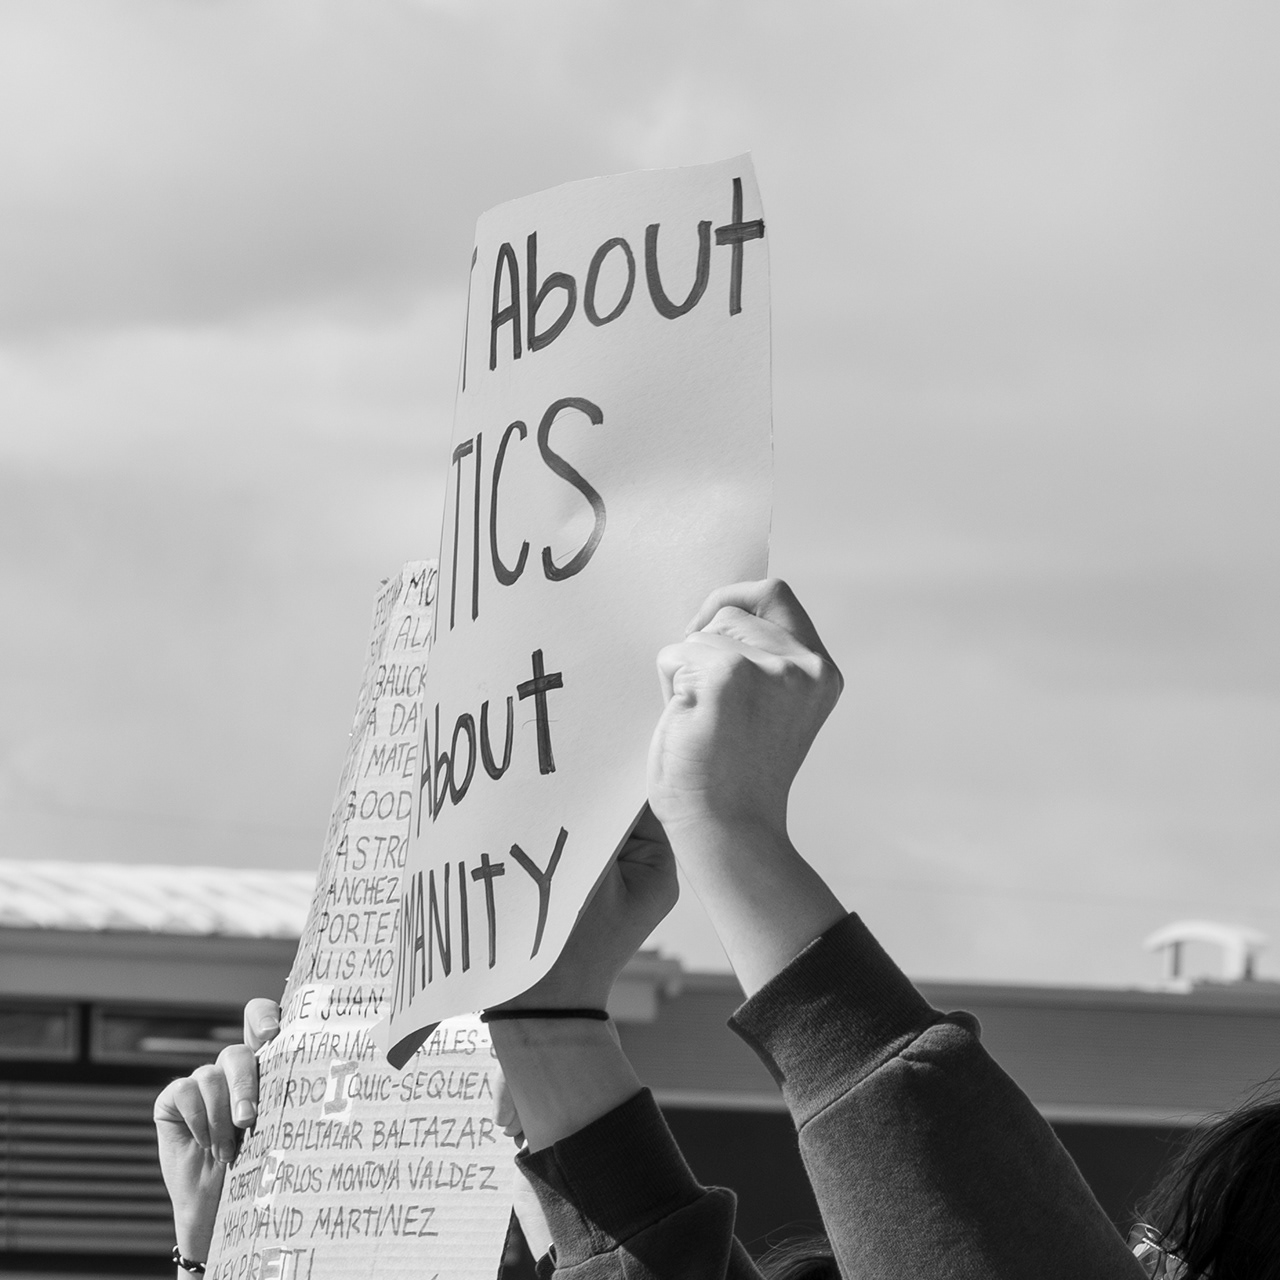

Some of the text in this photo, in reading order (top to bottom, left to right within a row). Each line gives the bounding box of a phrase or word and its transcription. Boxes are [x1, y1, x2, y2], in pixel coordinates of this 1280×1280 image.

[489, 177, 766, 372] About
[413, 646, 564, 838] About
[327, 875, 401, 907] ANCHEZ
[281, 1117, 363, 1152] BALTAZAR
[372, 1115, 498, 1152] BALTAZAR
[326, 1159, 400, 1195] MONTOYA
[249, 1203, 304, 1241] DAVID
[310, 1203, 438, 1240] MARTINEZ
